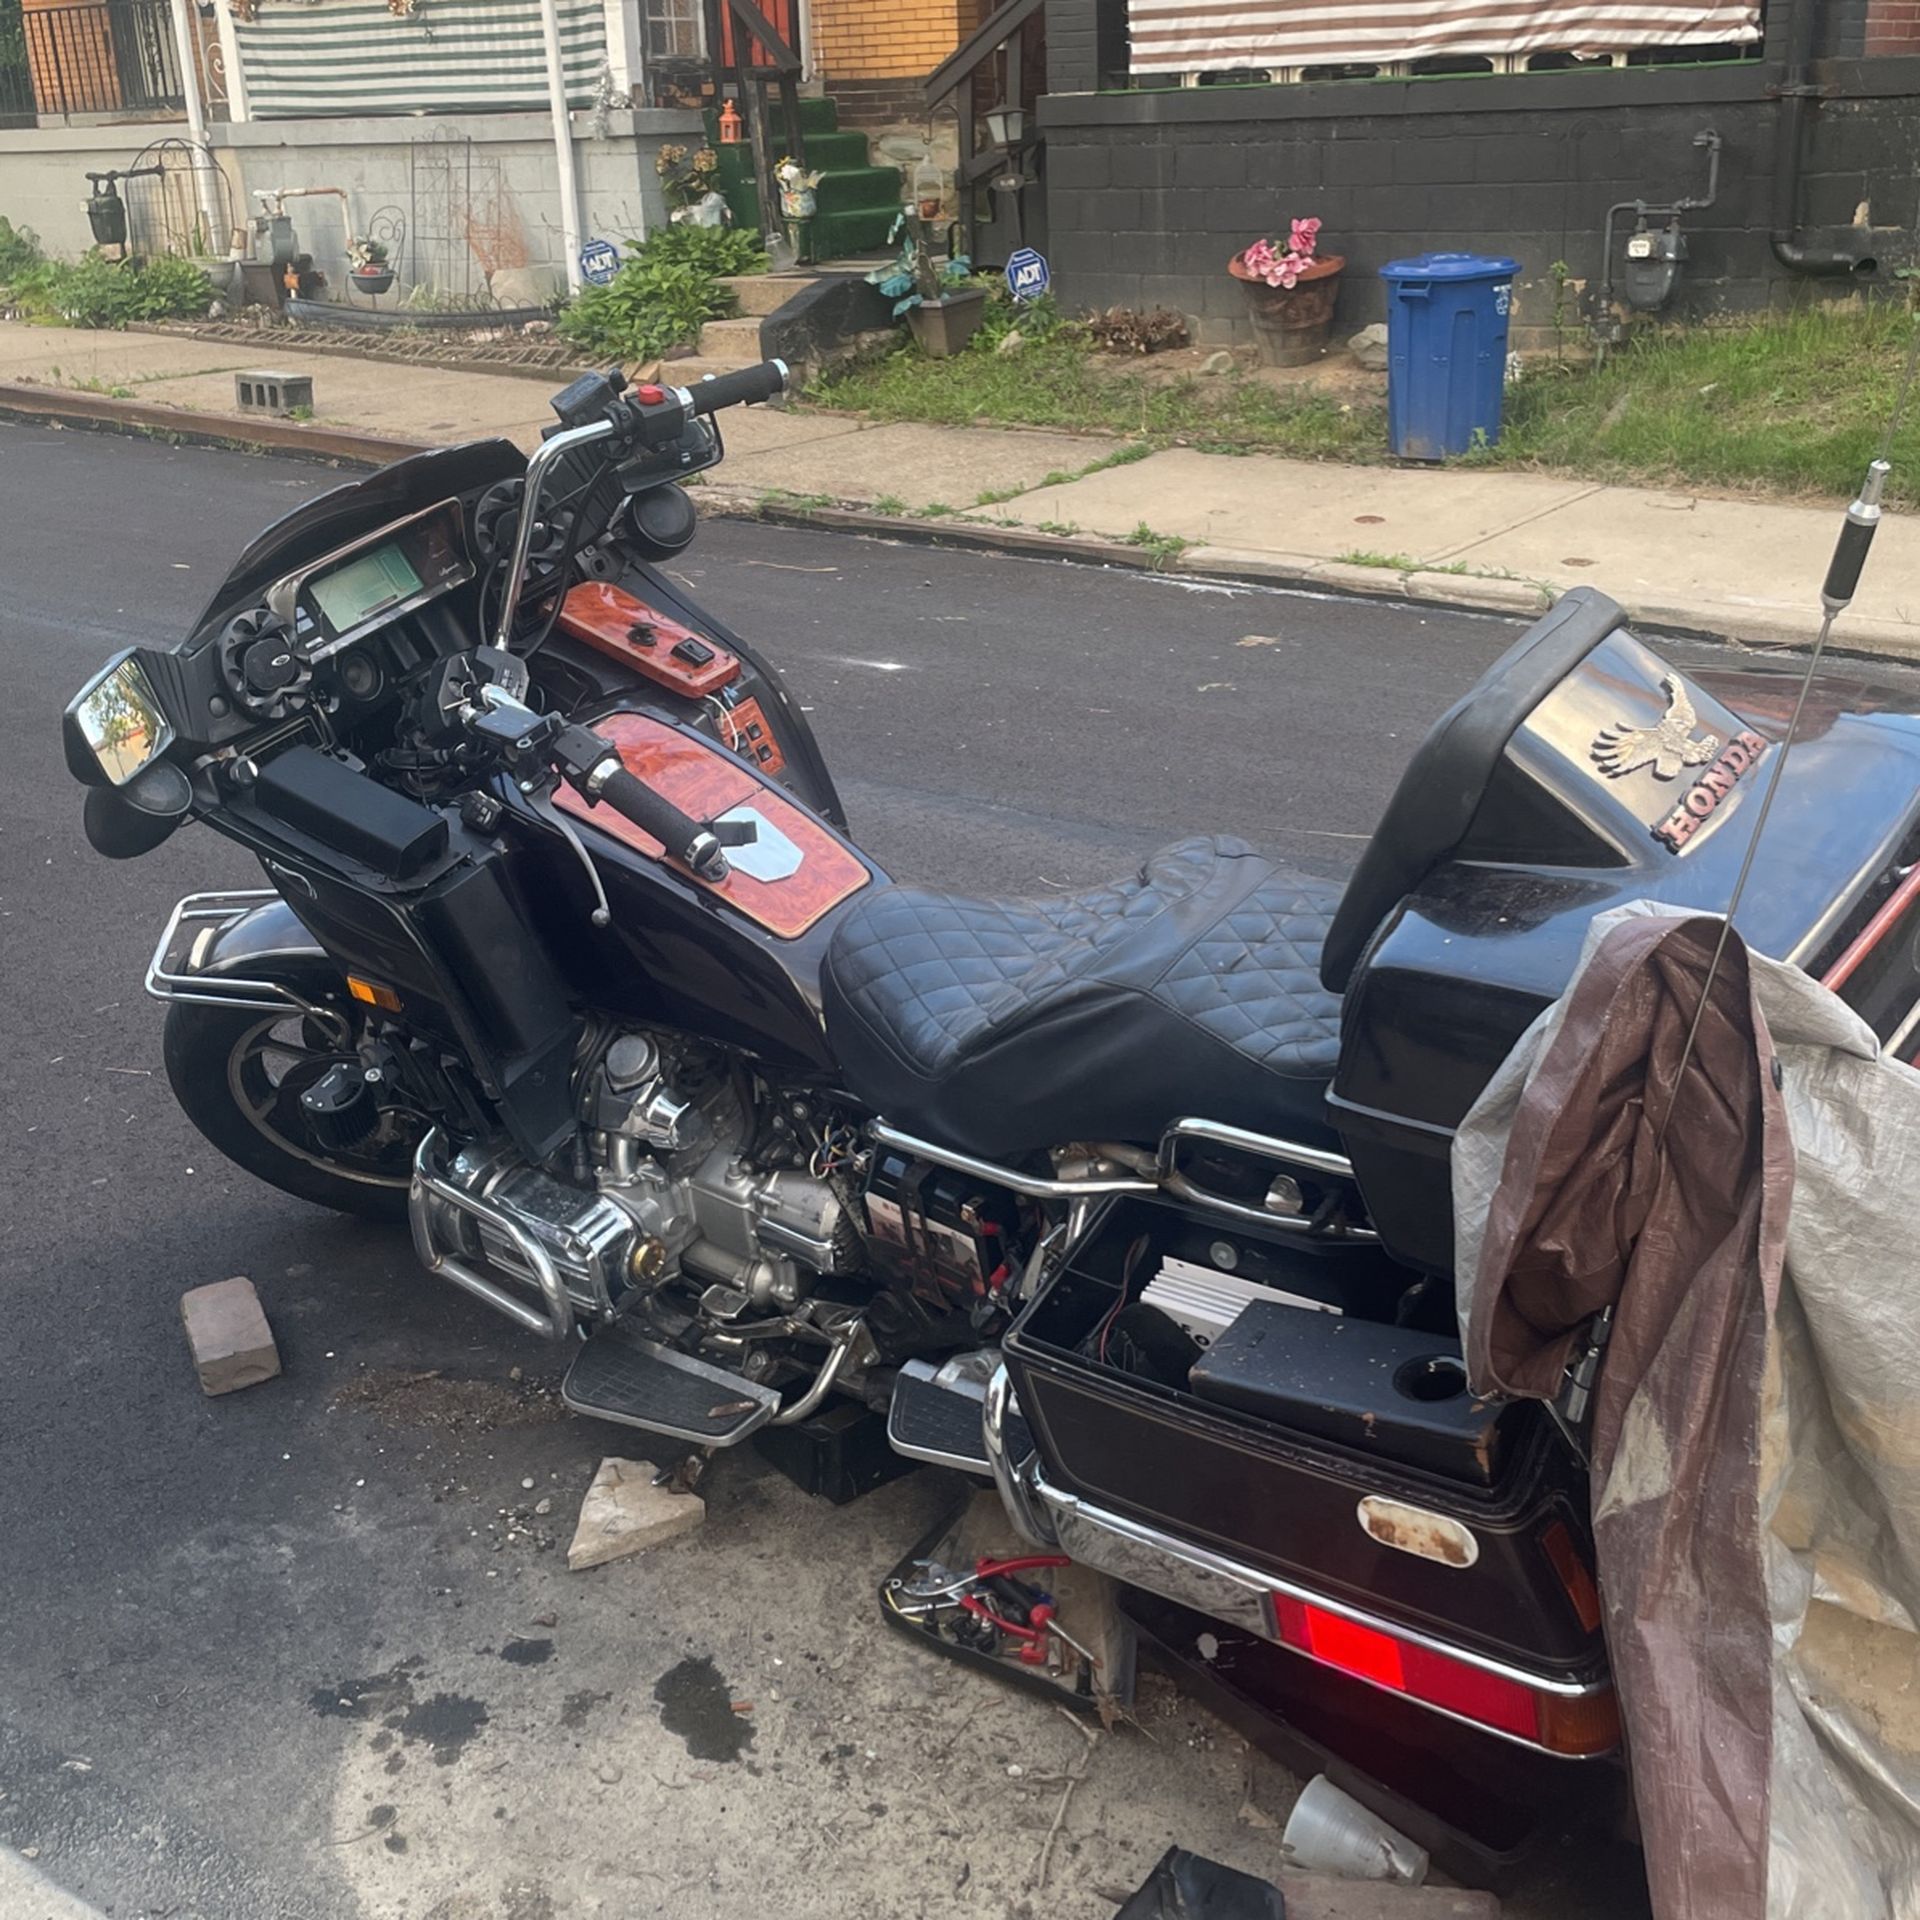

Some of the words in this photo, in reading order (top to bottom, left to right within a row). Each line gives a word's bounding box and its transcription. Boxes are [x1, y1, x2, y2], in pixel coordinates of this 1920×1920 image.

[587, 252, 613, 273] ADT
[1017, 262, 1041, 287] ADT
[1656, 731, 1767, 850] HONDA
